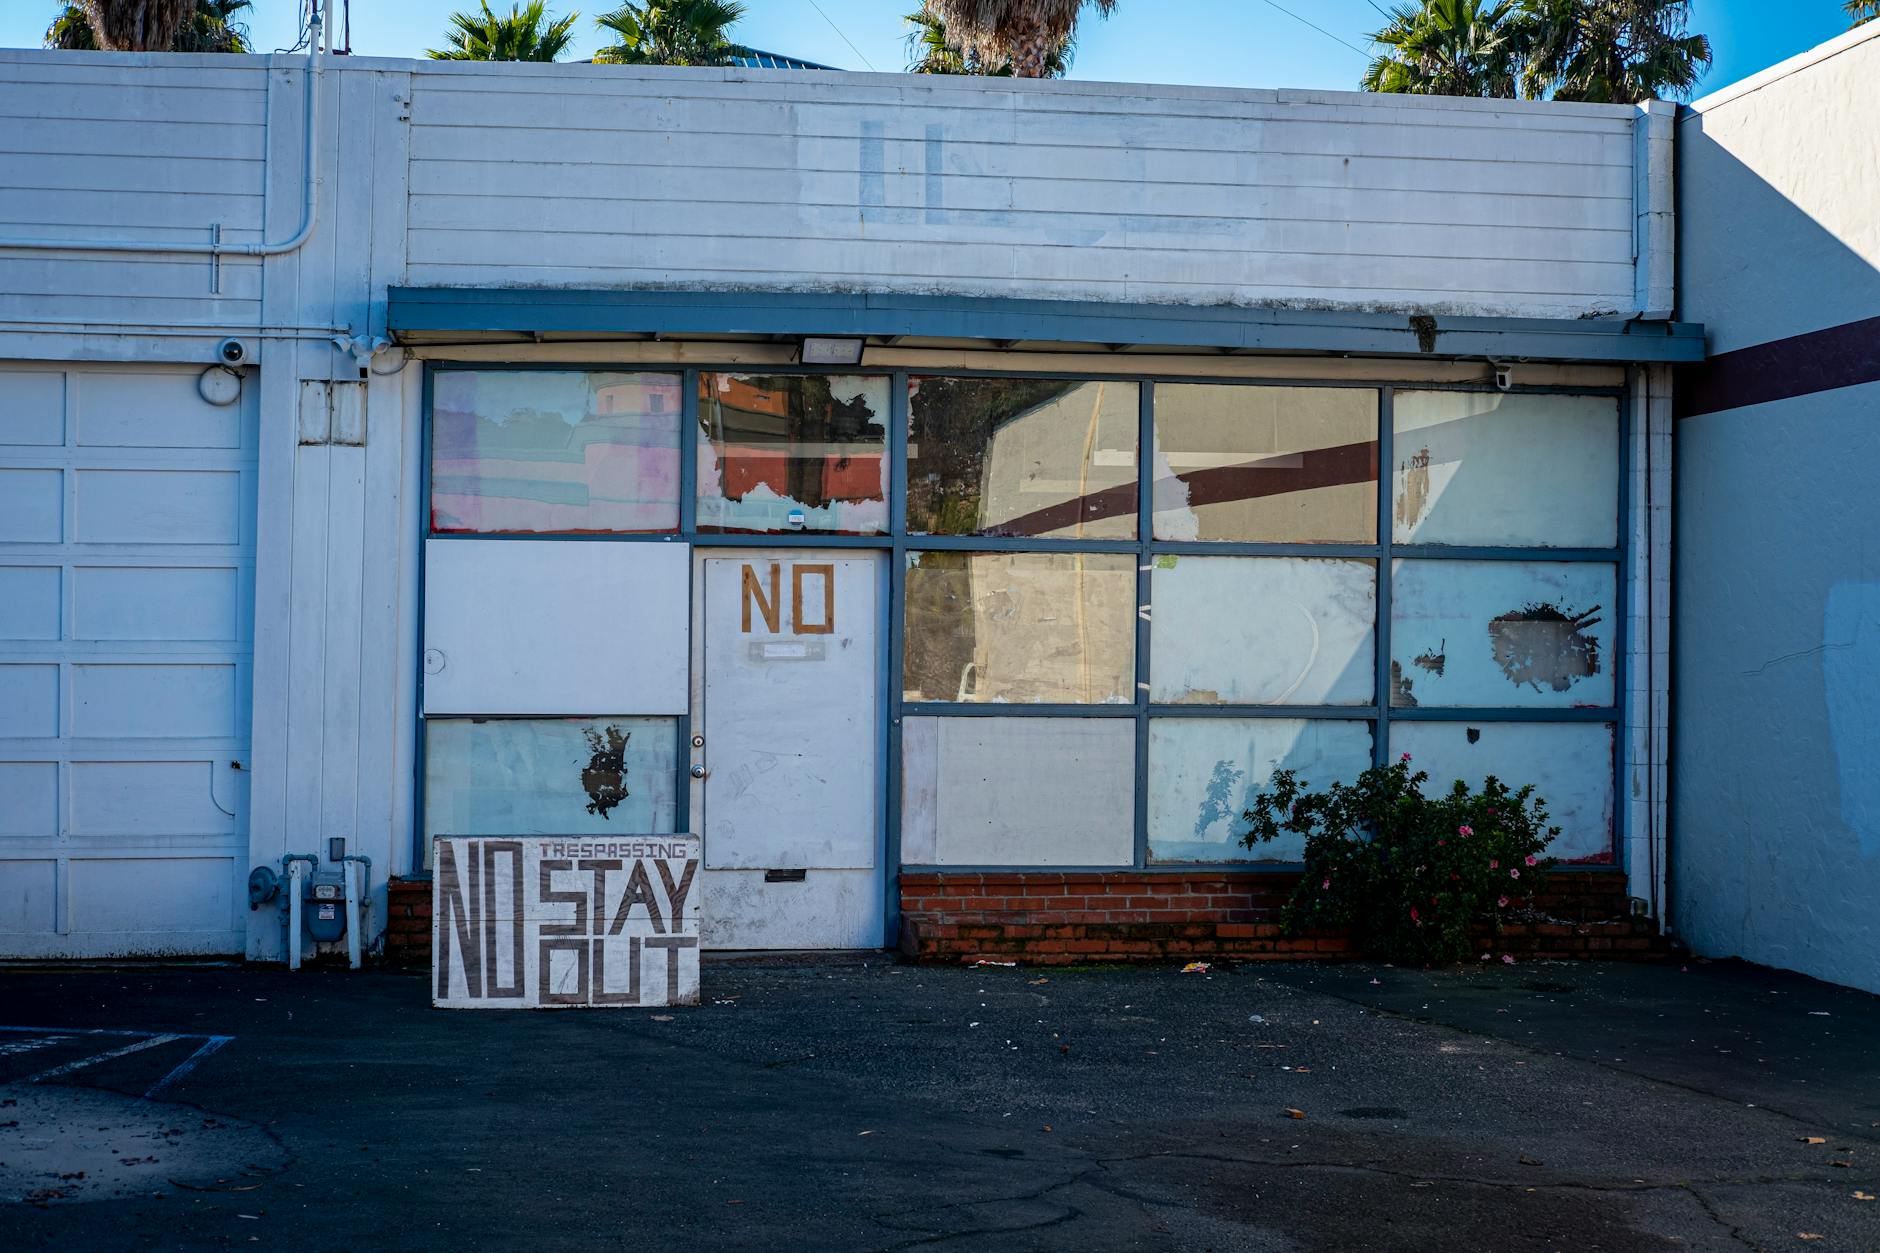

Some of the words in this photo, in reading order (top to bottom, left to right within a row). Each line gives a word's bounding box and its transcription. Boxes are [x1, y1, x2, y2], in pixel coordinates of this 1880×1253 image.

[741, 563, 834, 635] NO
[539, 843, 687, 859] TRESPASSING
[437, 840, 525, 999] NO
[539, 859, 699, 936] STAY
[539, 936, 698, 1005] OUT
